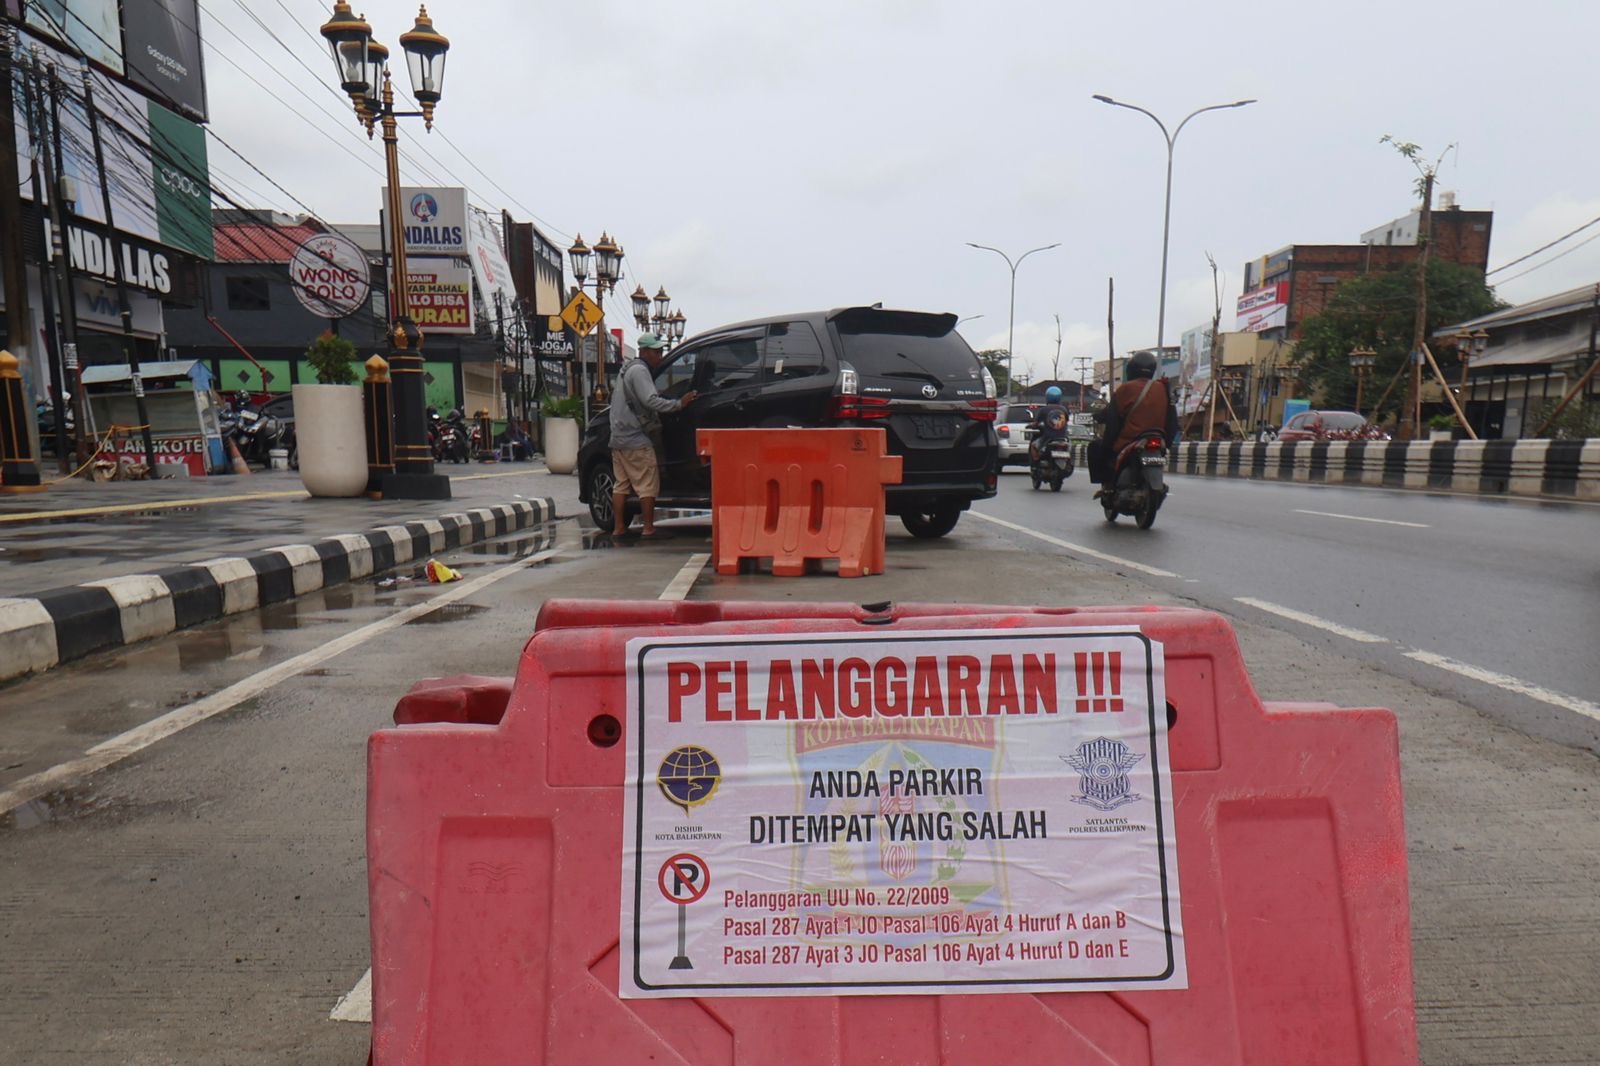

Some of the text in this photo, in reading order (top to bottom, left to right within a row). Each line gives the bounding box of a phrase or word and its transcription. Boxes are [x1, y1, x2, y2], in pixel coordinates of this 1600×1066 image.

[402, 226, 462, 245] NDALAS
[299, 268, 359, 284] WONG
[305, 284, 356, 300] SOLO
[408, 284, 463, 293] YAR MAHAL
[408, 295, 465, 306] ALO BISA
[409, 309, 466, 324] URAH
[546, 331, 565, 342] MIE
[539, 341, 573, 352] JOGJA
[667, 651, 1124, 723] PELANGGARAN !!!
[803, 717, 987, 749] KOTA BALIKPAPAN
[809, 768, 983, 799] ANDA PARKIR
[750, 810, 1047, 844] DITEMPAT YANG SALAH
[724, 886, 949, 911] Pelanggaran UU No. 22/2009
[724, 910, 1126, 939] Pasal 287 Ayat 1 JO Pasal 106 Ayat 4 Huruf A dan B
[724, 939, 1129, 967] Pasal 287 Ayat 3 JO Pasal 106 Ayat 4 Huruf D dan E
